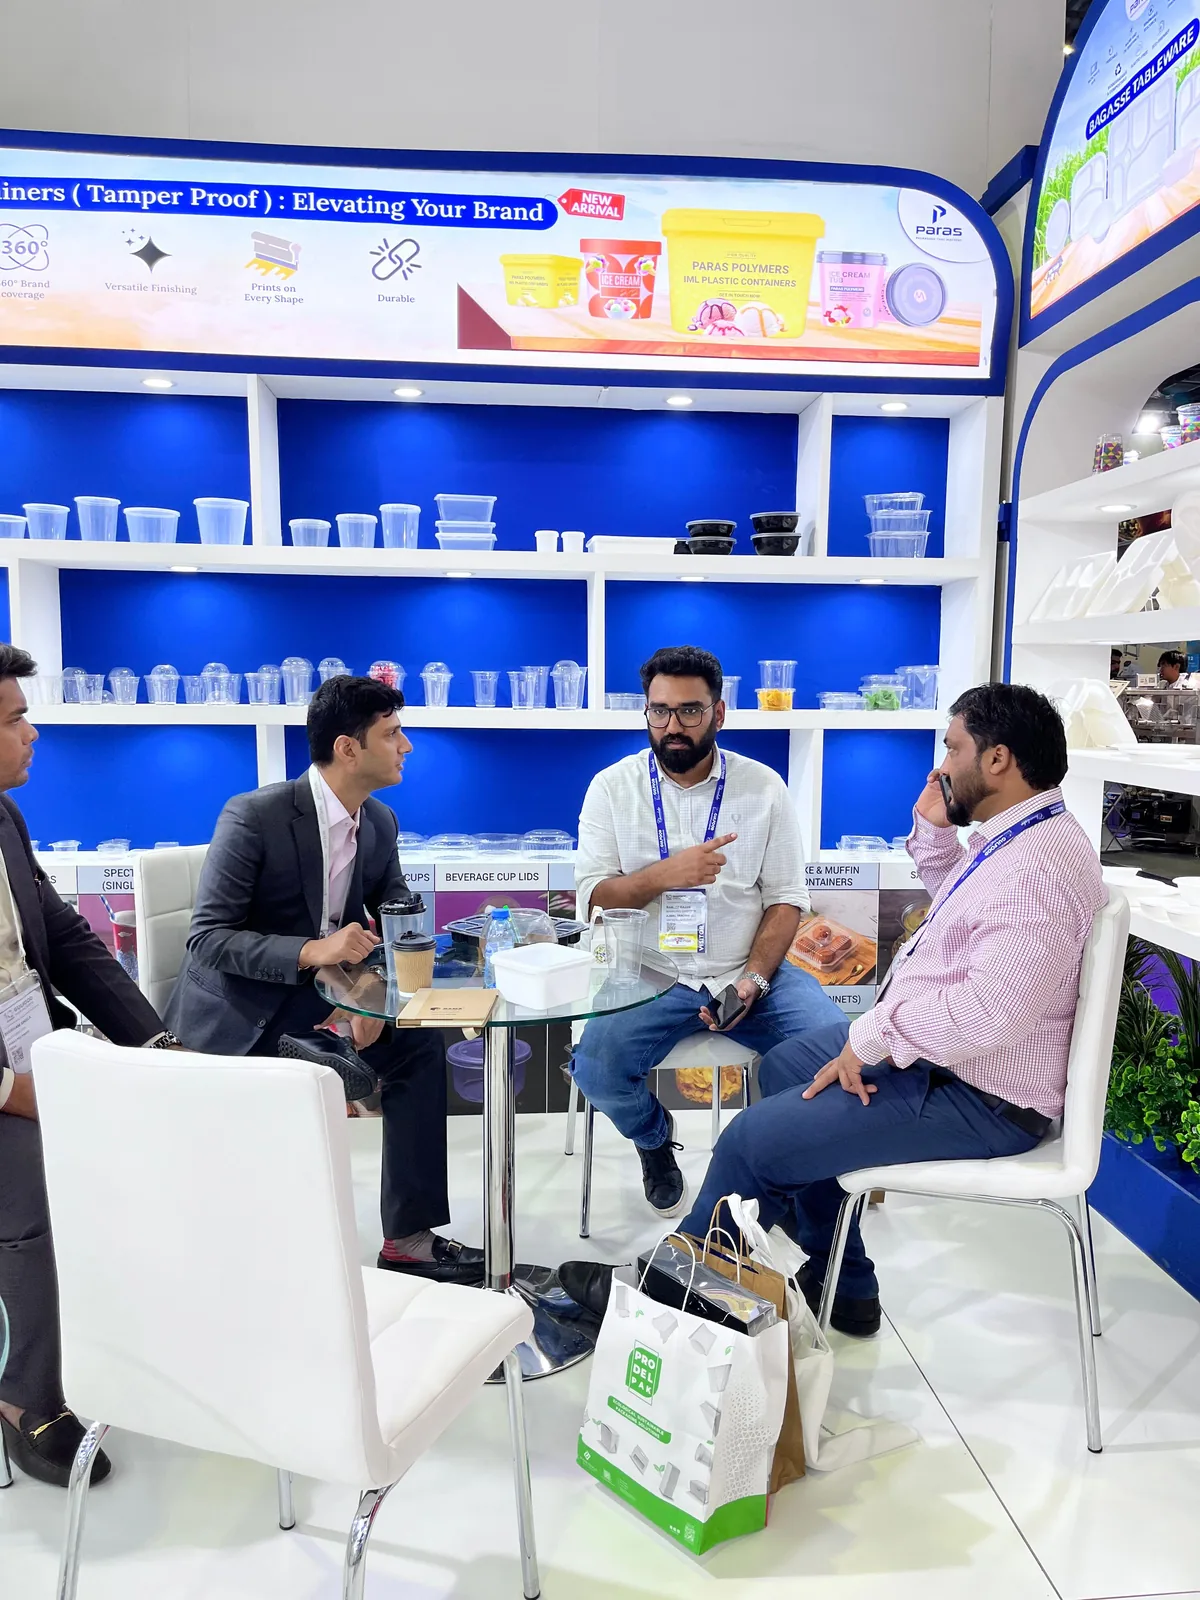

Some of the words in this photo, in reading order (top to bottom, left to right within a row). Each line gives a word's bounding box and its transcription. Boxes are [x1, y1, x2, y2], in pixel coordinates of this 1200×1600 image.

[1088, 86, 1131, 134] BAGASSE
[1132, 26, 1195, 94] TABLEWARE
[0, 182, 65, 201] iners
[87, 184, 184, 209] Tamper
[190, 187, 258, 209] Proof
[292, 192, 406, 221] Elevating
[411, 198, 466, 219] Your
[473, 201, 544, 221] Brand
[582, 192, 612, 205] NEW
[571, 203, 620, 218] ARRIVAL
[692, 261, 729, 272] PARAS
[732, 262, 789, 275] POLYMERS
[0, 279, 18, 288] 60°
[21, 279, 50, 289] Brand
[601, 274, 613, 285] ICE
[614, 274, 640, 286] CREAM
[683, 275, 699, 284] IML
[701, 276, 739, 285] PLASTIC
[741, 278, 796, 288] CONTAINERS
[104, 282, 149, 292] Versatile
[151, 284, 197, 296] Finishing
[251, 283, 281, 292] Prints
[284, 285, 296, 293] on
[244, 294, 272, 304] Every
[275, 294, 304, 305] Shape
[378, 294, 415, 303] Durable
[445, 873, 494, 881] BEVERAGE
[496, 873, 516, 881] CUP
[518, 872, 539, 881] LIDS
[816, 866, 823, 875] &
[825, 866, 860, 874] MUFFIN
[404, 873, 430, 882] CUPS
[634, 1350, 656, 1370] PRO
[632, 1363, 653, 1383] DEL
[631, 1376, 652, 1395] PAK
